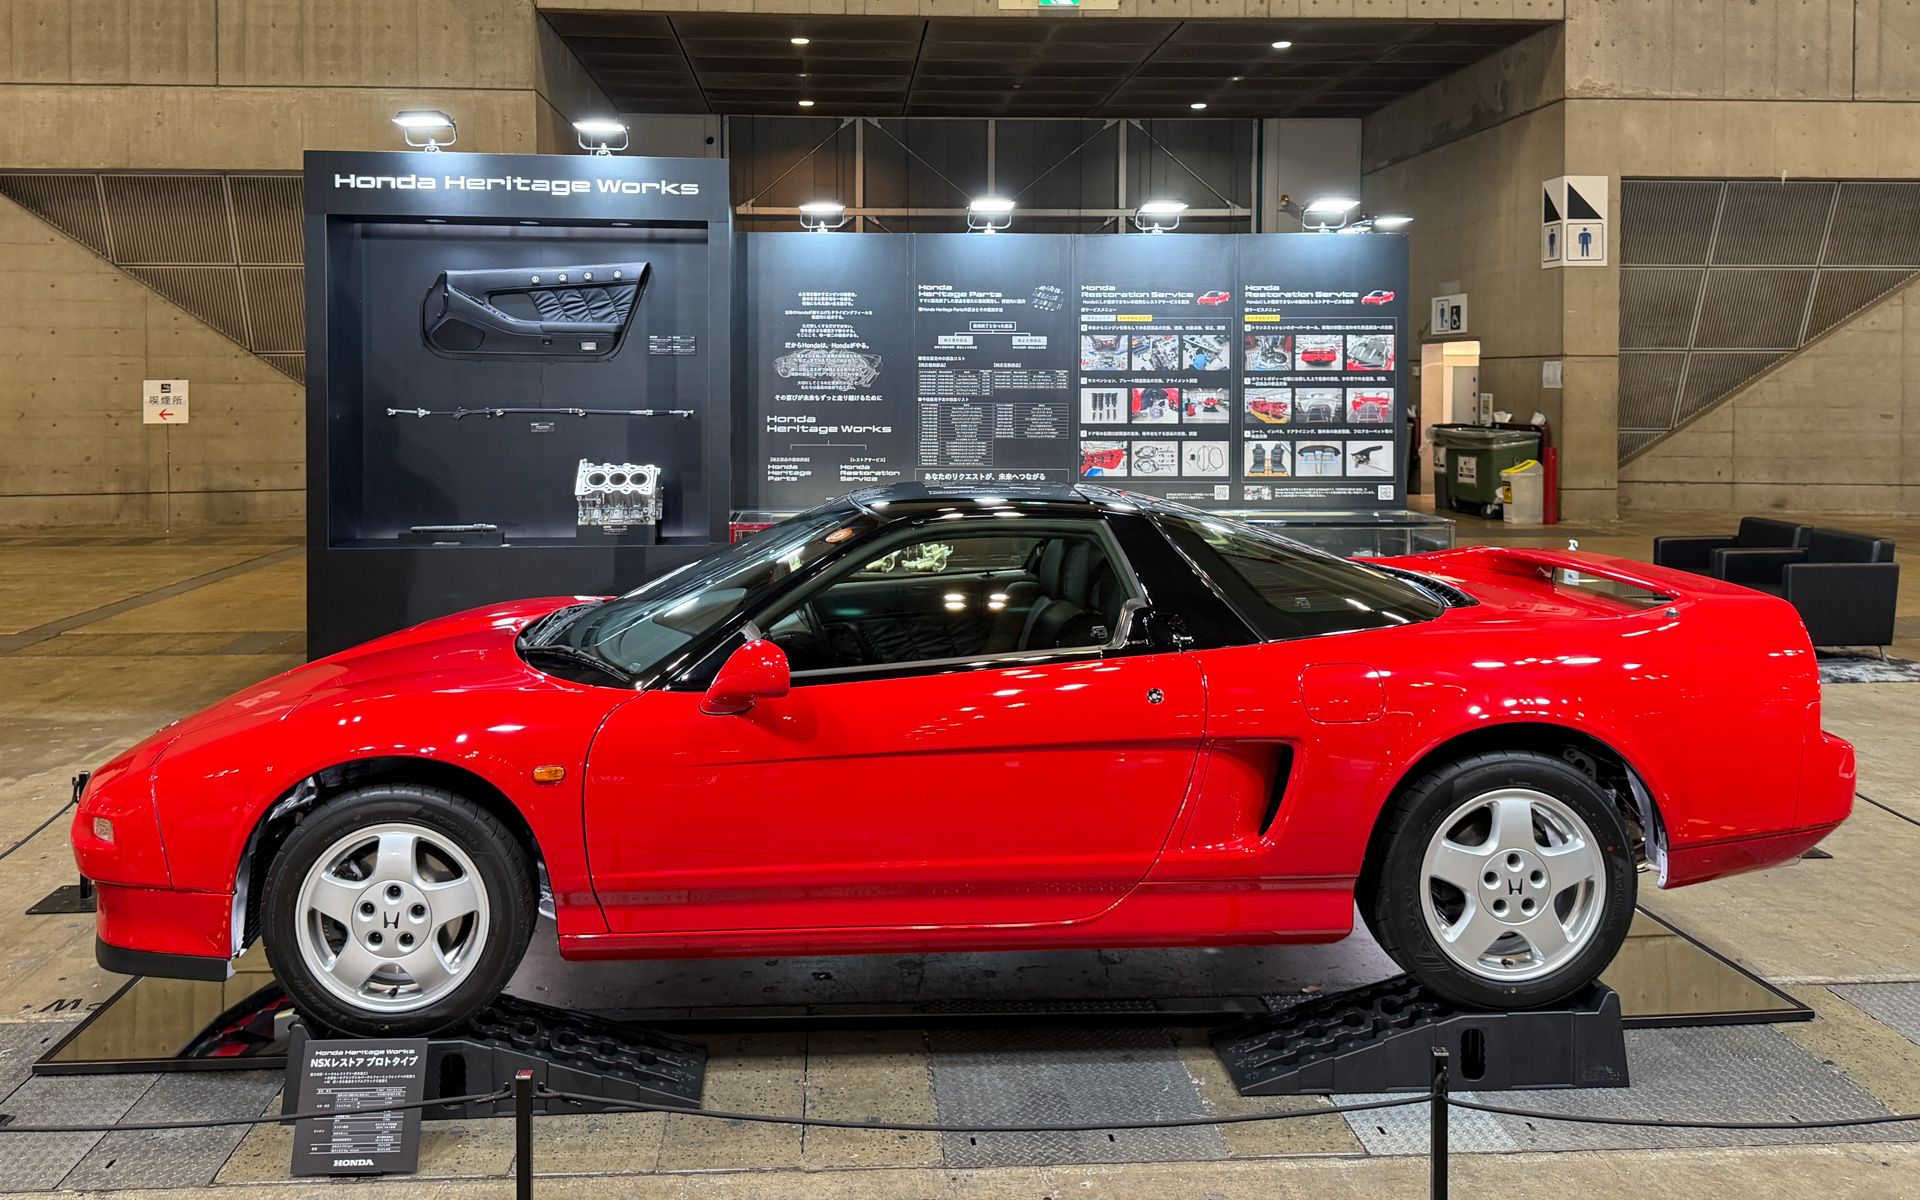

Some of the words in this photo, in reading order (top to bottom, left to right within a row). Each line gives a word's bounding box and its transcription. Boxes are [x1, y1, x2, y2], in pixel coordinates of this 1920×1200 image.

[334, 173, 437, 190] Honda
[445, 176, 591, 196] Heritage
[597, 179, 700, 196] Works
[149, 395, 182, 405] 喫煙所
[767, 415, 816, 423] Honda
[767, 425, 838, 434] Heritage
[841, 425, 892, 433] Works
[924, 473, 1046, 481] あなたのリクエストが、未来へつながる
[310, 1057, 365, 1068] NSXレストア
[367, 1055, 419, 1067] プロトタイプ
[333, 1159, 374, 1167] HONDA
